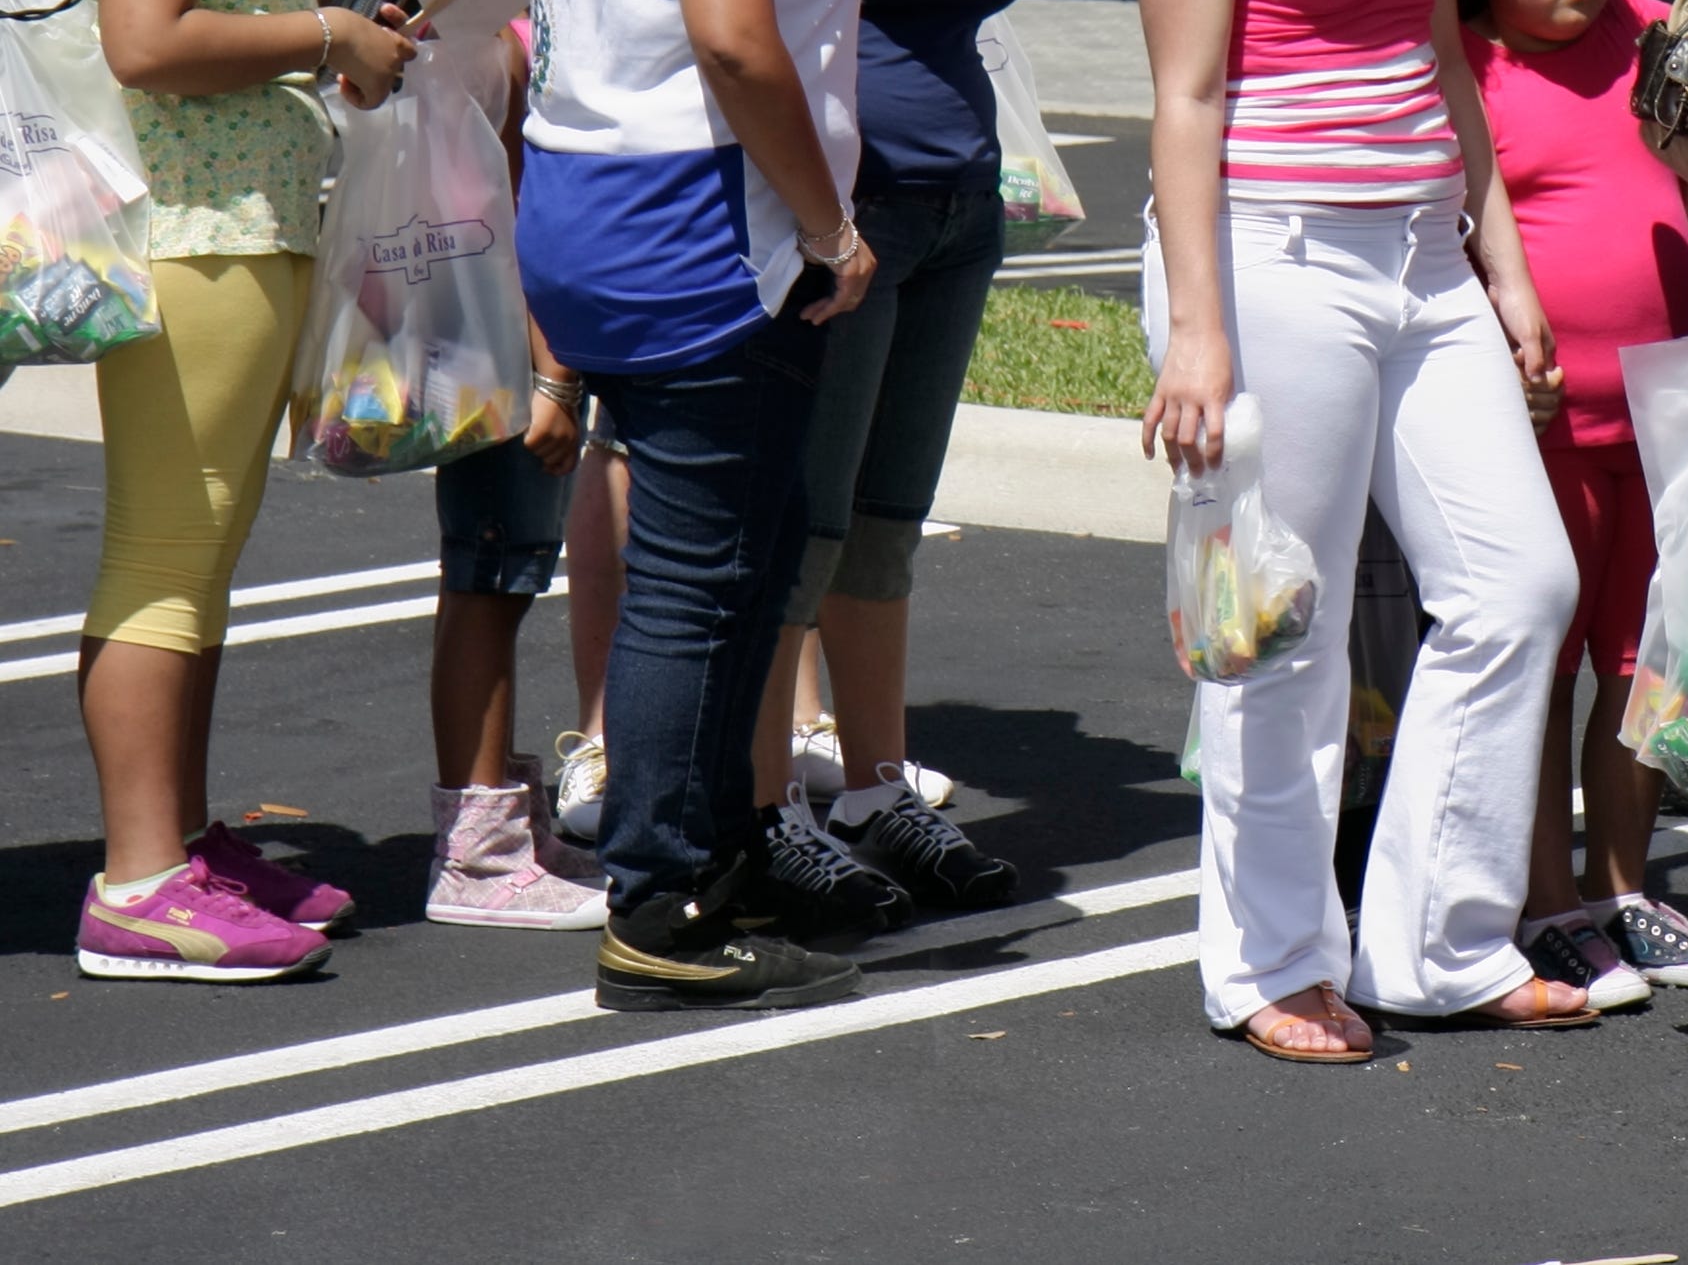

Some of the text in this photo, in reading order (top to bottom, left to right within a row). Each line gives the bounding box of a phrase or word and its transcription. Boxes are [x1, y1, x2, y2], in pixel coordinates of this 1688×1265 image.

[22, 123, 58, 144] Risa
[372, 242, 407, 264] Casa
[425, 231, 456, 253] Risa
[724, 945, 755, 962] FILA
